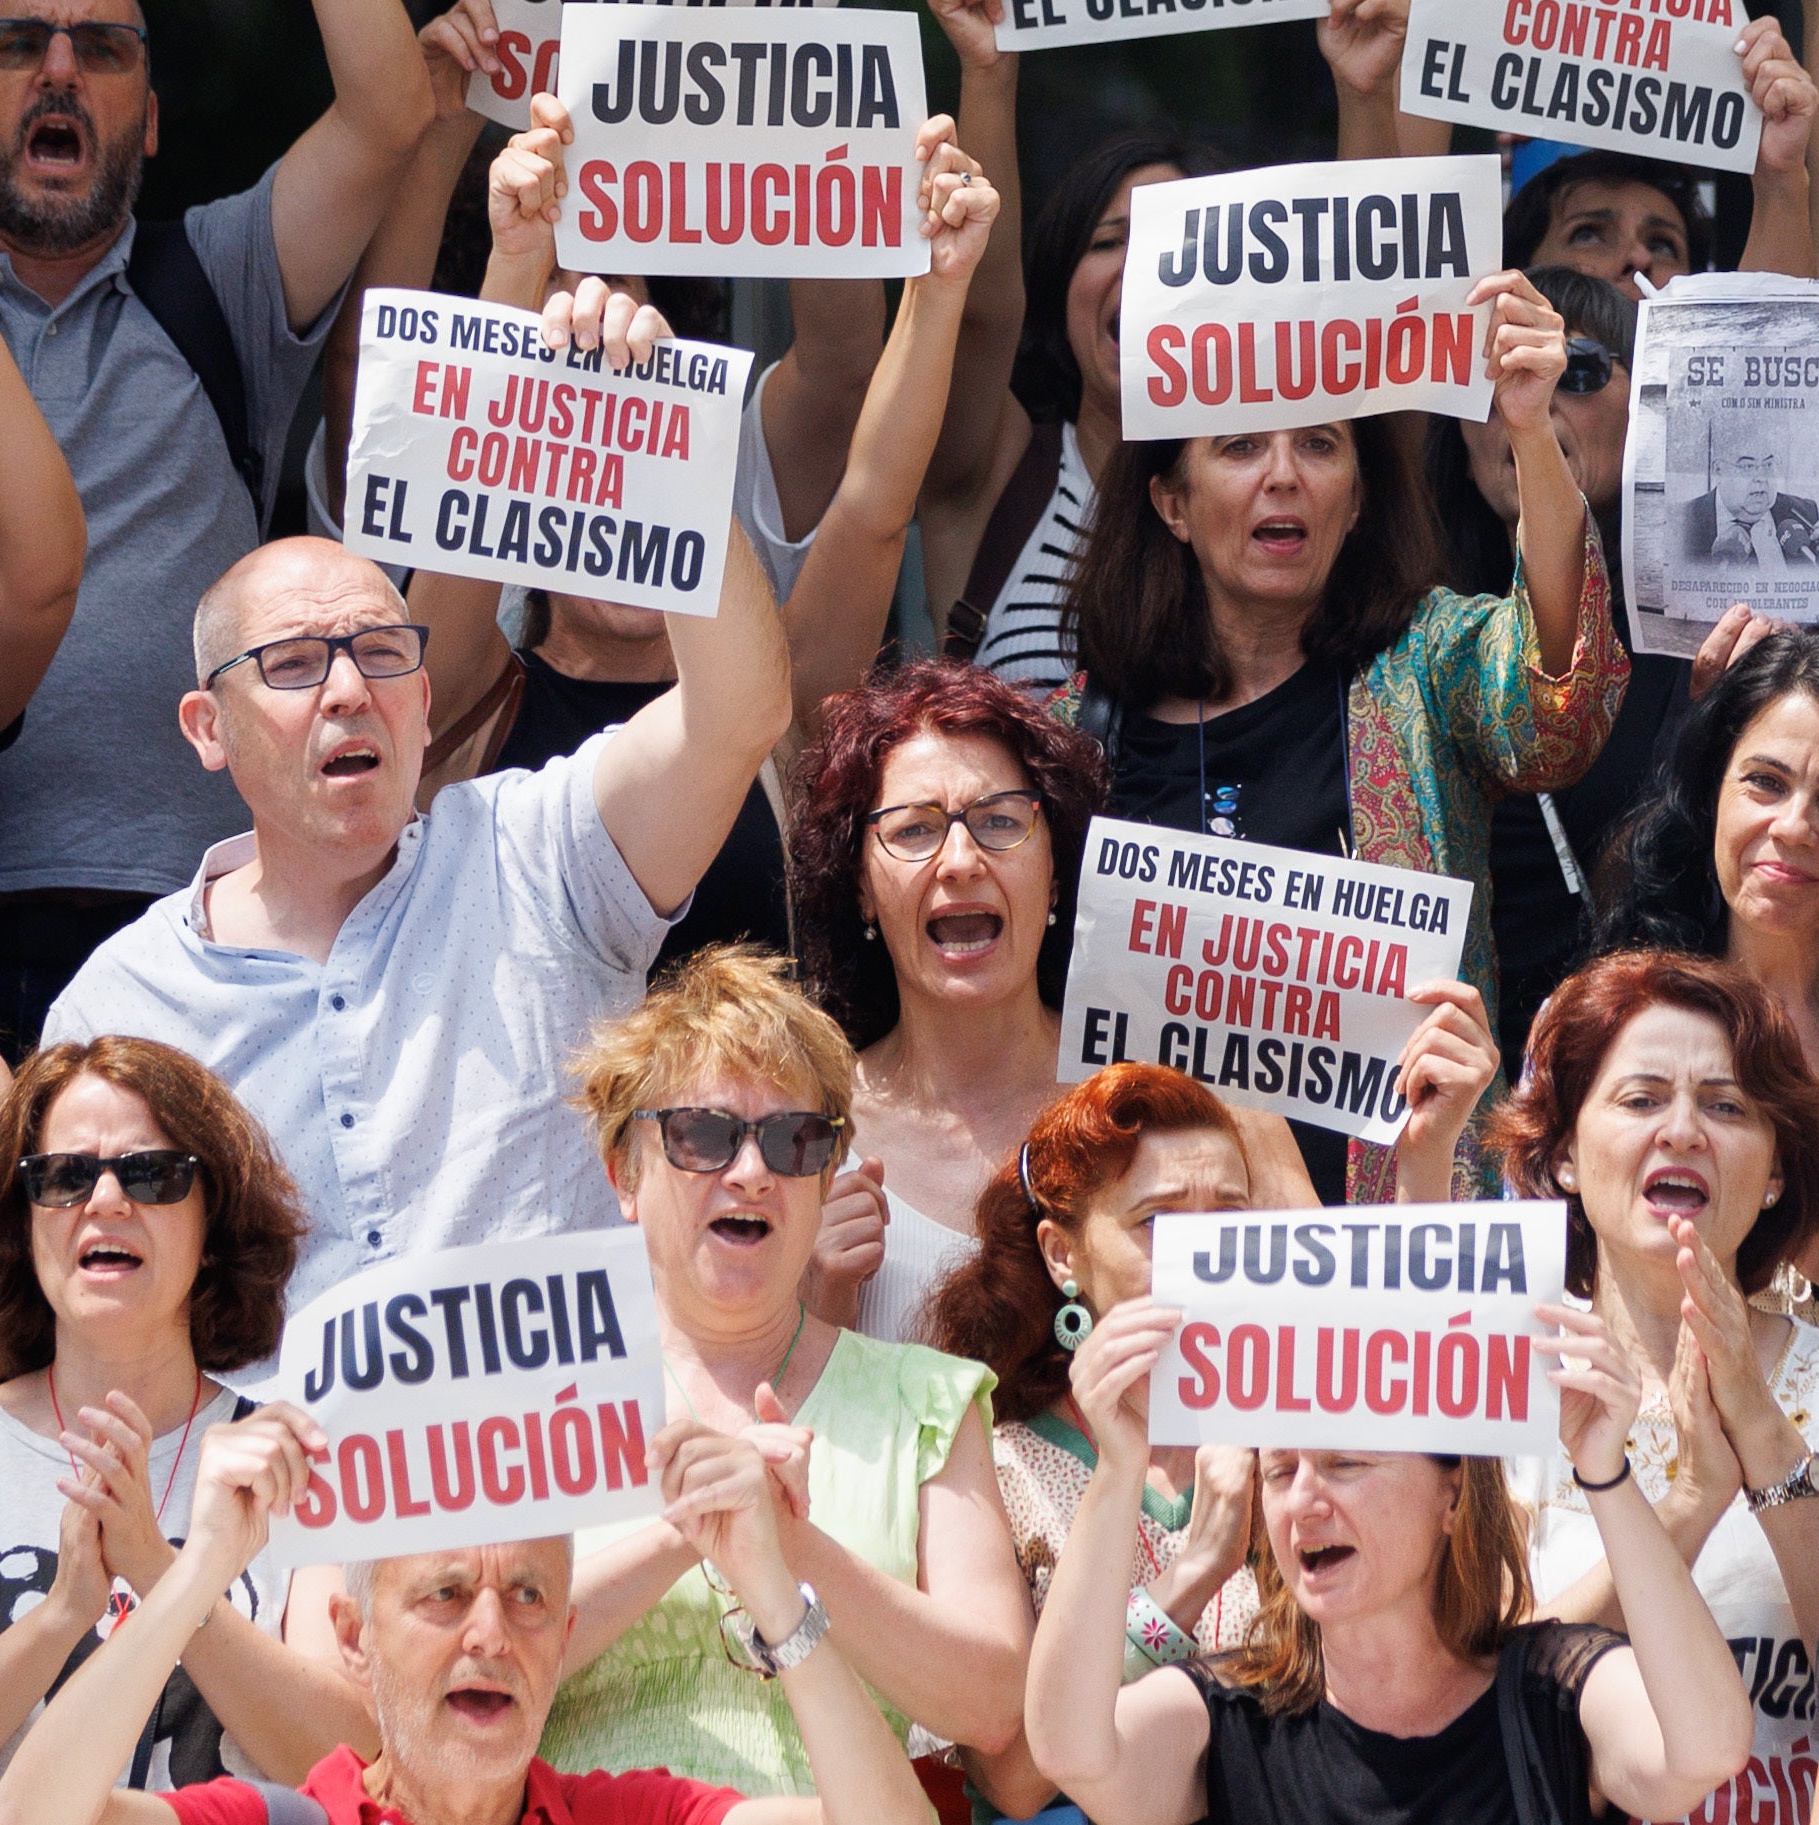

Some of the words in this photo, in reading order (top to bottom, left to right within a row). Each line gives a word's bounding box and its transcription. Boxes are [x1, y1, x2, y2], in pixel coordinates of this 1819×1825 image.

[591, 39, 901, 129] JUSTICIA
[1420, 38, 1471, 103] EL
[1490, 52, 1746, 150] CLASISMO
[578, 142, 903, 248] SOLUCIÓN
[1158, 192, 1470, 288] JUSTICIA
[377, 305, 439, 344] DOS
[450, 315, 556, 364] MESES
[1146, 295, 1474, 408] SOLUCIÓN
[1687, 356, 1724, 387] SE
[412, 360, 472, 421] EN
[487, 374, 691, 461] JUSTICIA
[446, 426, 625, 510] CONTRA
[361, 473, 413, 544] EL
[435, 489, 706, 592] CLASISMO
[1671, 580, 1749, 593] DESAPARECIDO
[1097, 838, 1160, 882] DOS
[1168, 850, 1276, 902] MESES
[1284, 870, 1324, 912] EN
[1333, 878, 1450, 935] HUELGA
[1128, 898, 1188, 959] EN
[1202, 914, 1409, 999] JUSTICIA
[1164, 964, 1341, 1043] CONTRA
[1081, 1007, 1130, 1066] EL
[1159, 1021, 1407, 1124] CLASISMO
[1192, 1222, 1528, 1295] JUSTICIA
[304, 1268, 627, 1405] JUSTICIA
[1178, 1310, 1531, 1423] SOLUCIÓN
[294, 1382, 648, 1529] SOLUCIÓN
